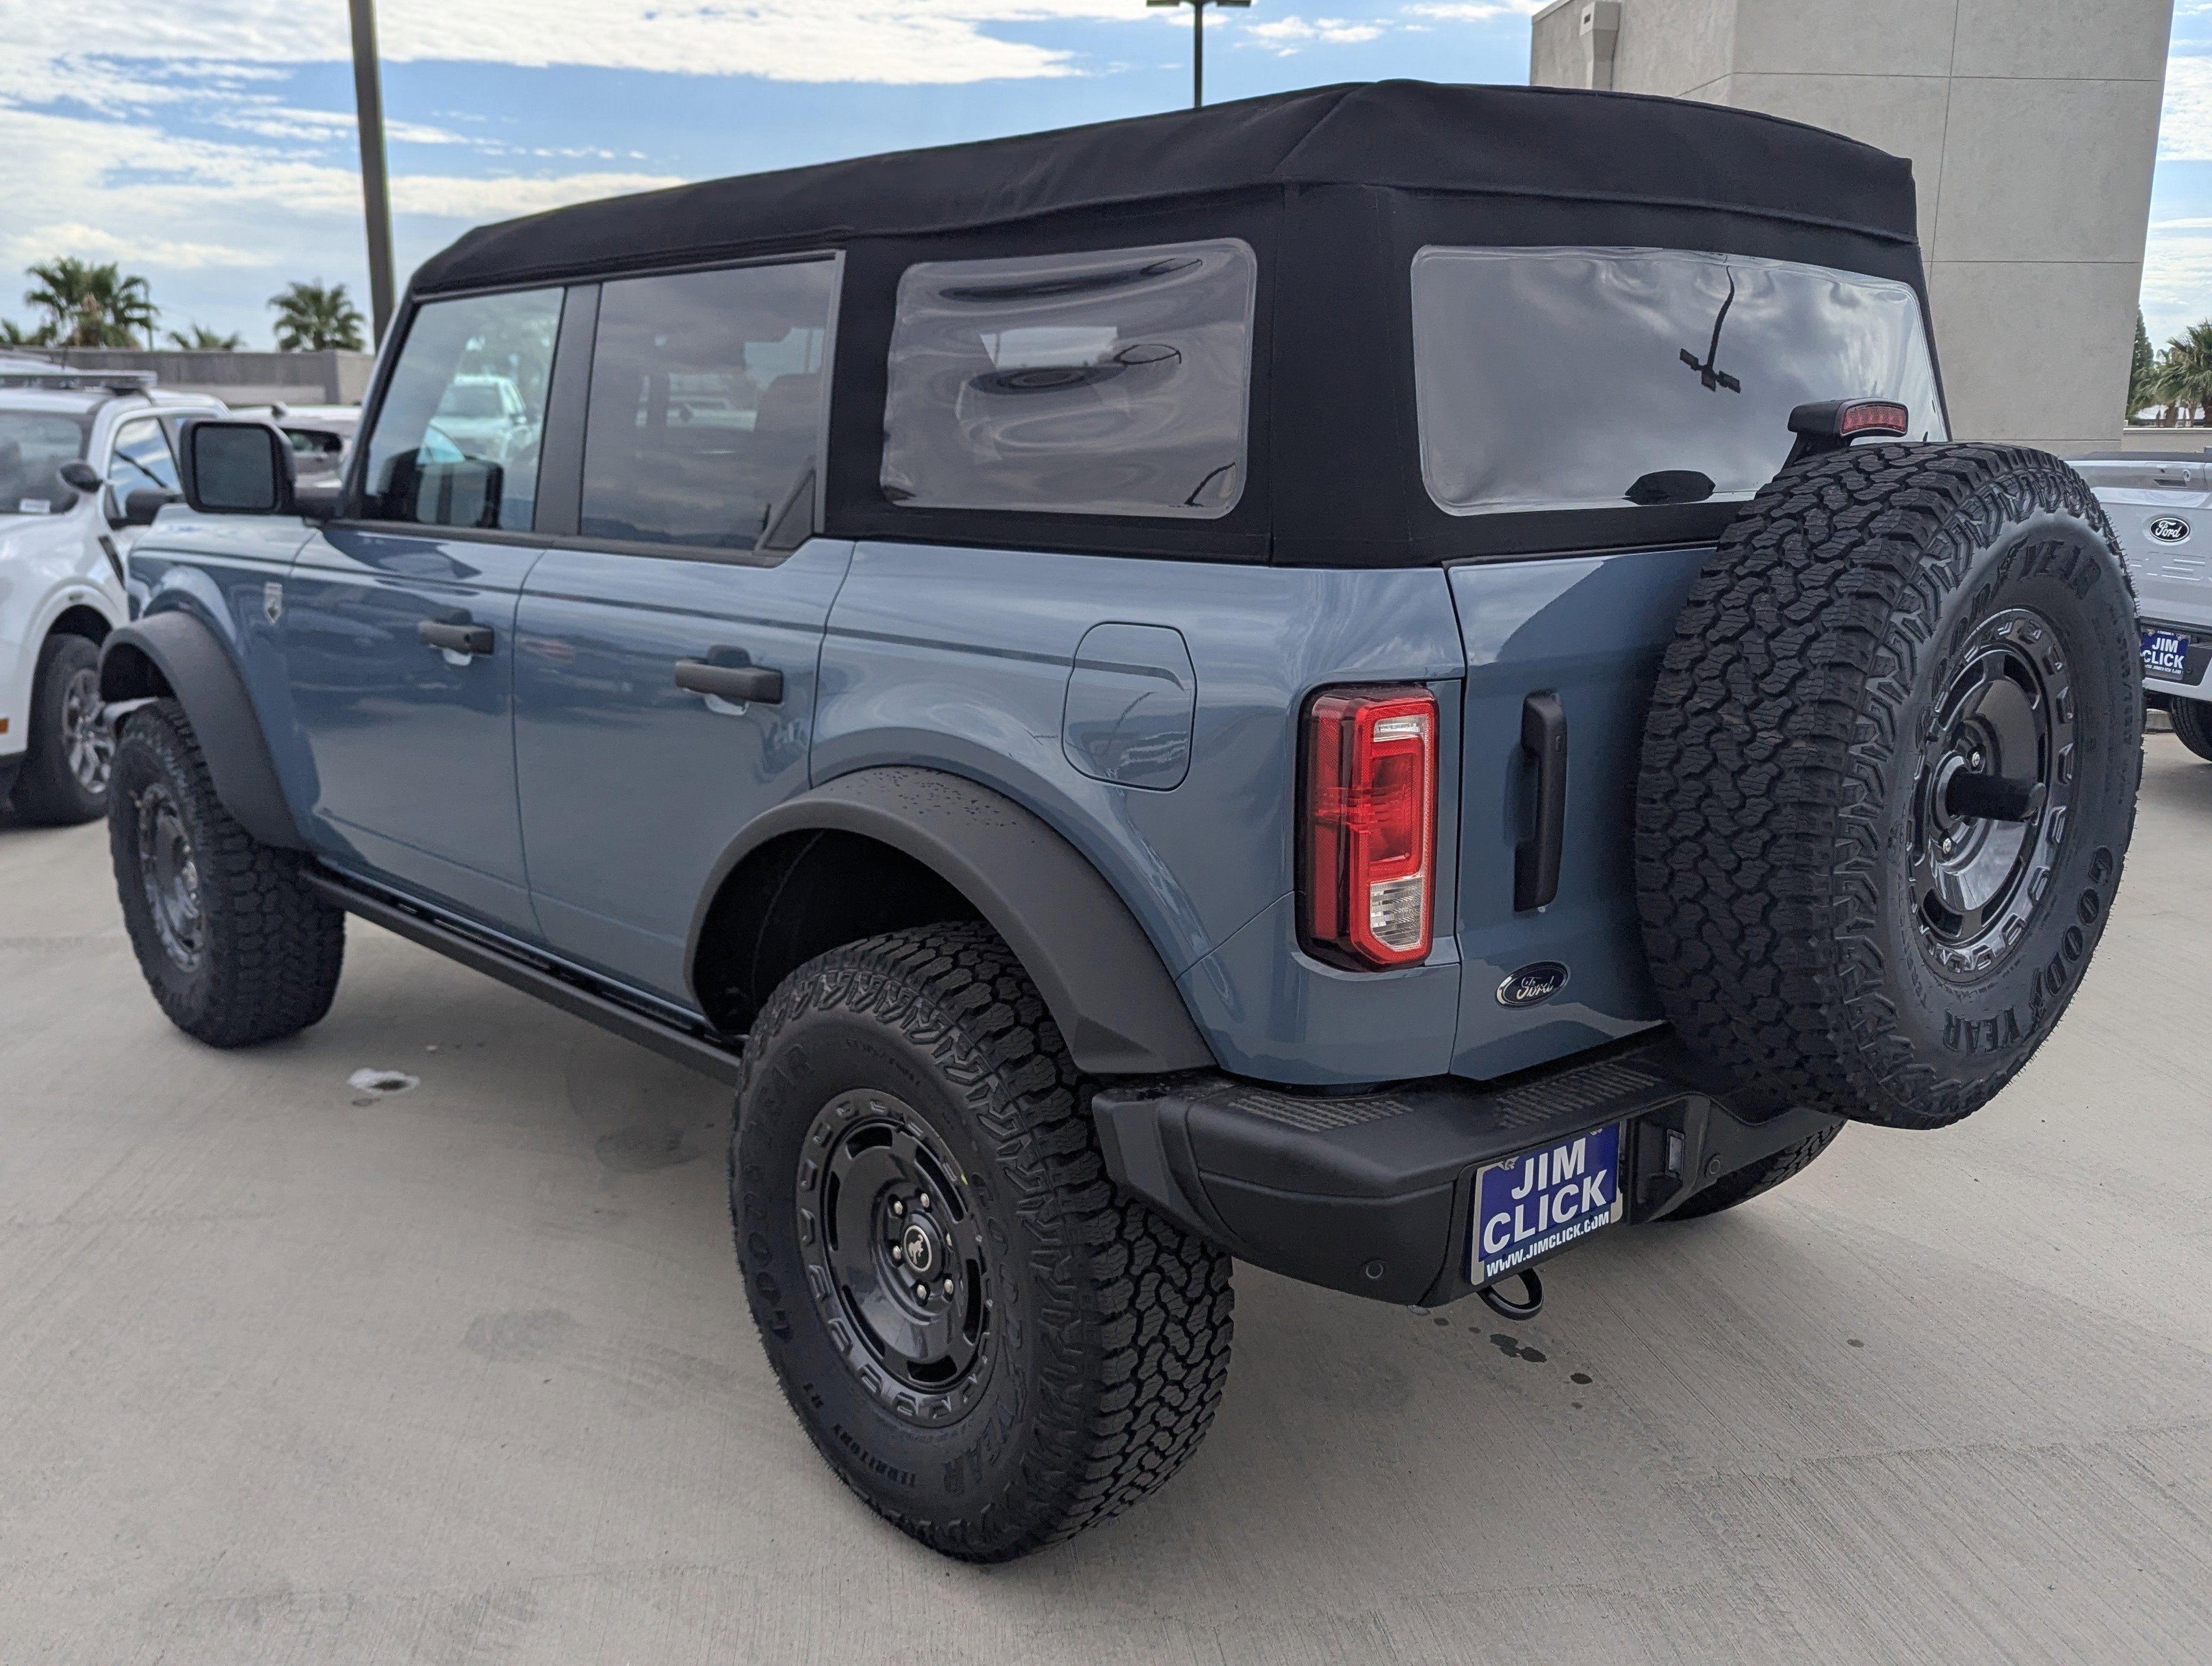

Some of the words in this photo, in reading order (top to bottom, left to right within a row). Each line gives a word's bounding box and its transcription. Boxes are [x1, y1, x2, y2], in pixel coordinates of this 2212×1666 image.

[2155, 520, 2182, 539] Ford
[2142, 649, 2185, 670] CLICK
[2152, 637, 2178, 653] JIM
[1516, 975, 1555, 1000] Ford
[1943, 1005, 2024, 1056] YEAR
[1512, 1138, 1586, 1200] JIM
[1483, 1169, 1607, 1254] CLICK
[1486, 1211, 1610, 1277] WWW.JIMCLICK.COM
